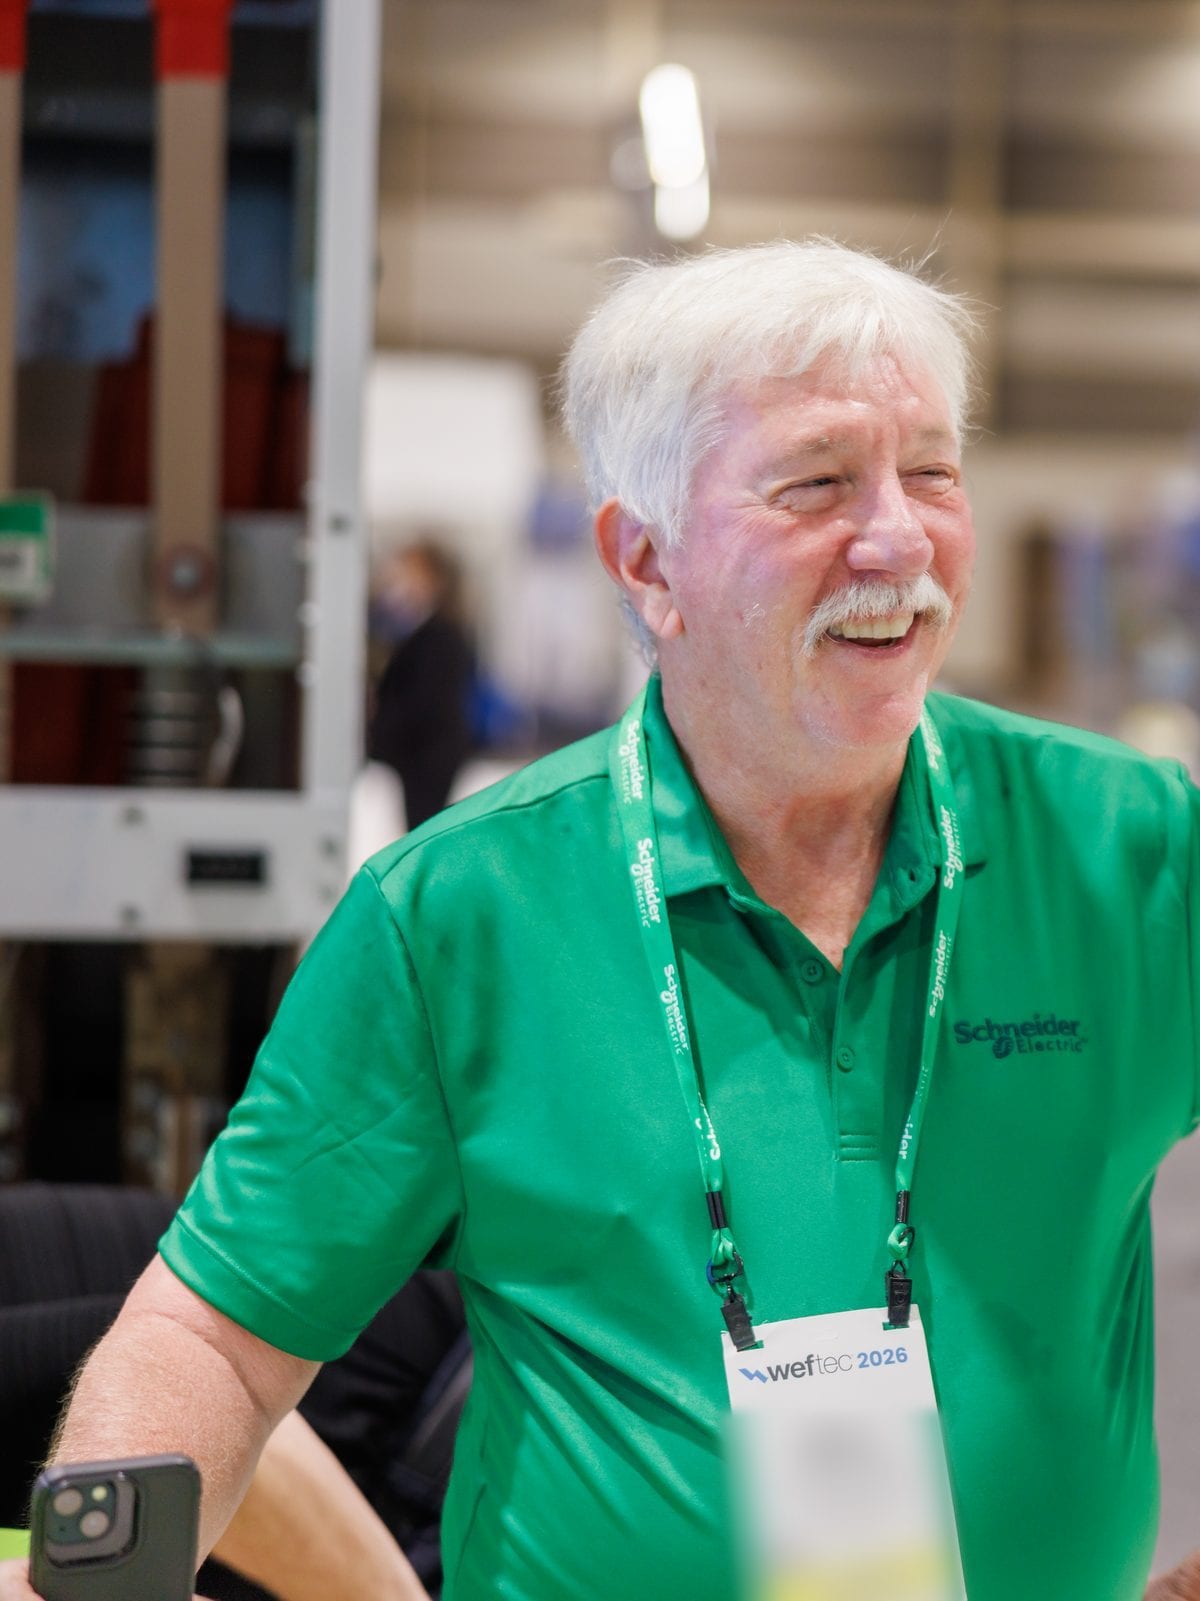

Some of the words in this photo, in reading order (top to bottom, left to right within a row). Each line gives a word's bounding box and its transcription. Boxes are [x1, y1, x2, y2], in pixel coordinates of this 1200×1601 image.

[628, 719, 645, 800] Schneider
[637, 837, 661, 923] Schneider
[940, 804, 956, 890] Schneider
[634, 877, 651, 928] Electric
[929, 929, 947, 1018] Schneider
[663, 963, 689, 1051] Schneider
[664, 1005, 685, 1056] Electric
[953, 1012, 1080, 1045] Schneider
[1015, 1037, 1084, 1054] Electric
[766, 1353, 854, 1383] weftec
[857, 1346, 909, 1369] 2026
